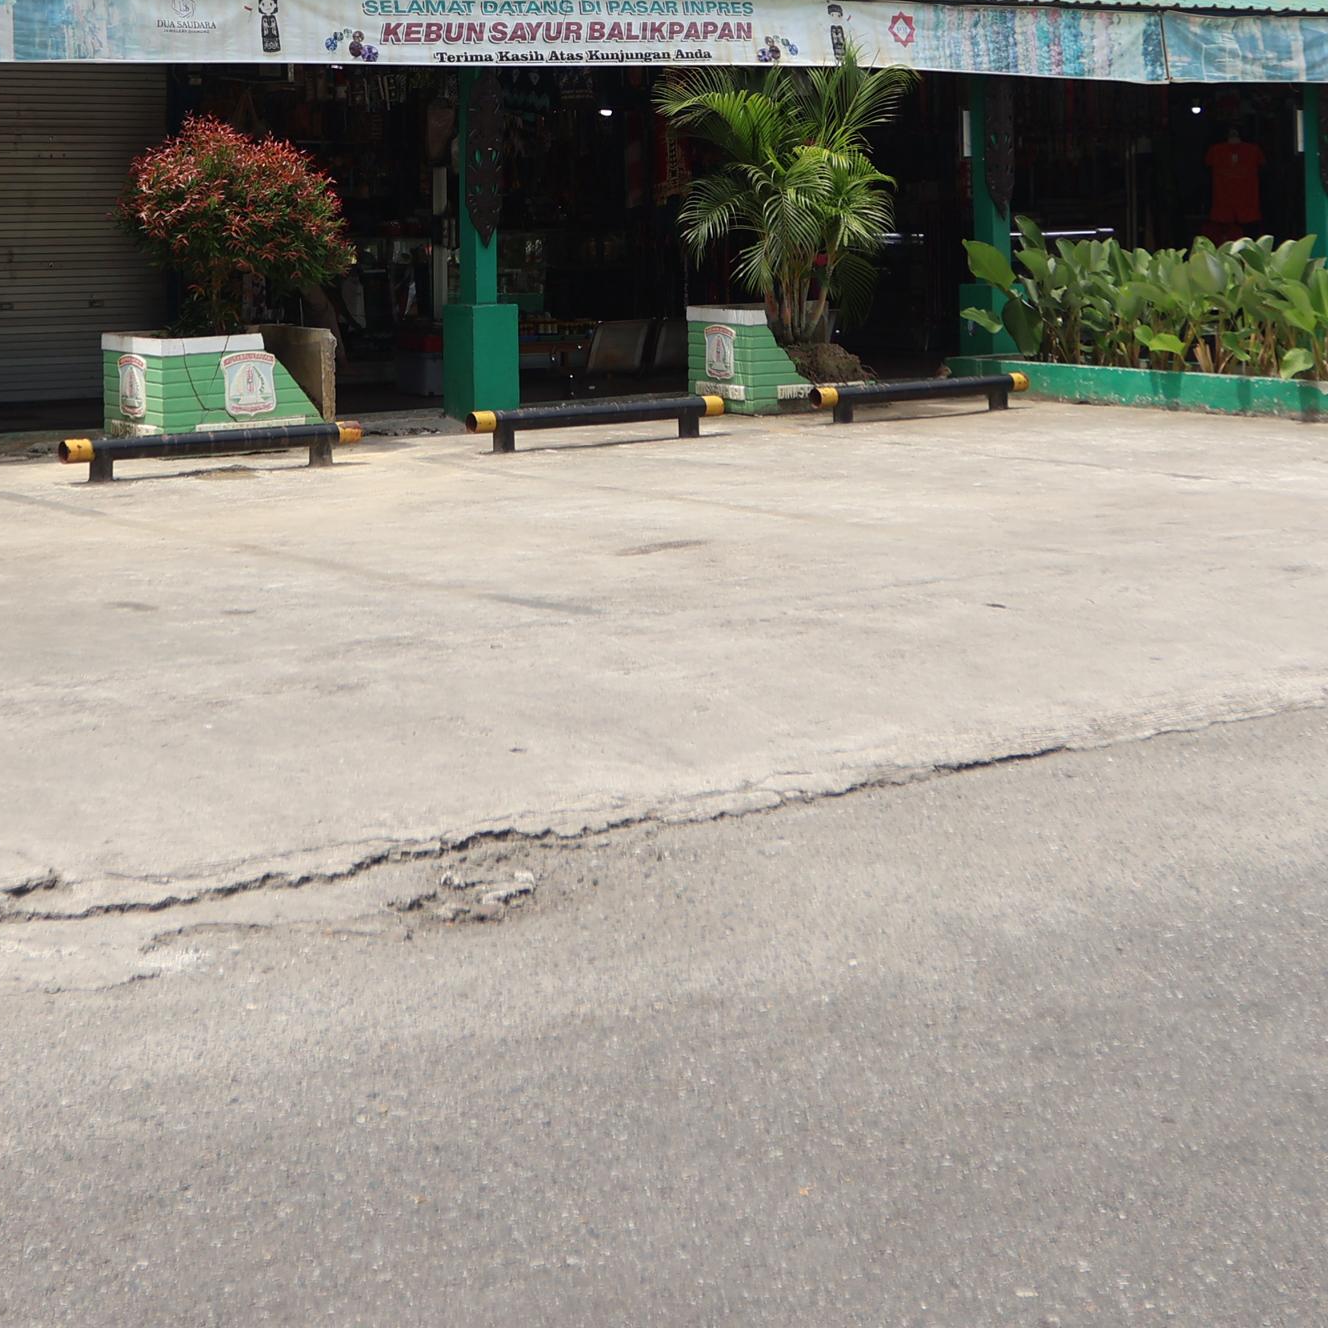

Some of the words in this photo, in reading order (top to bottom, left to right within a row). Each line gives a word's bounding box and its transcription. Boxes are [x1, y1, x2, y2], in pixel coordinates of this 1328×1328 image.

[363, 0, 475, 16] SELAMAT
[481, 0, 573, 16] DATANG
[580, 0, 602, 15] DI
[607, 0, 678, 16] PASAR
[683, 1, 754, 16] INPRES
[380, 22, 485, 44] KEBUN
[488, 22, 583, 43] SAYUR
[586, 22, 752, 43] BALIKPAPAN
[435, 52, 493, 63] Terima
[497, 51, 544, 62] Kasih
[547, 50, 583, 62] Atas
[586, 50, 671, 63] Kunjungan
[674, 49, 712, 60] Anda
